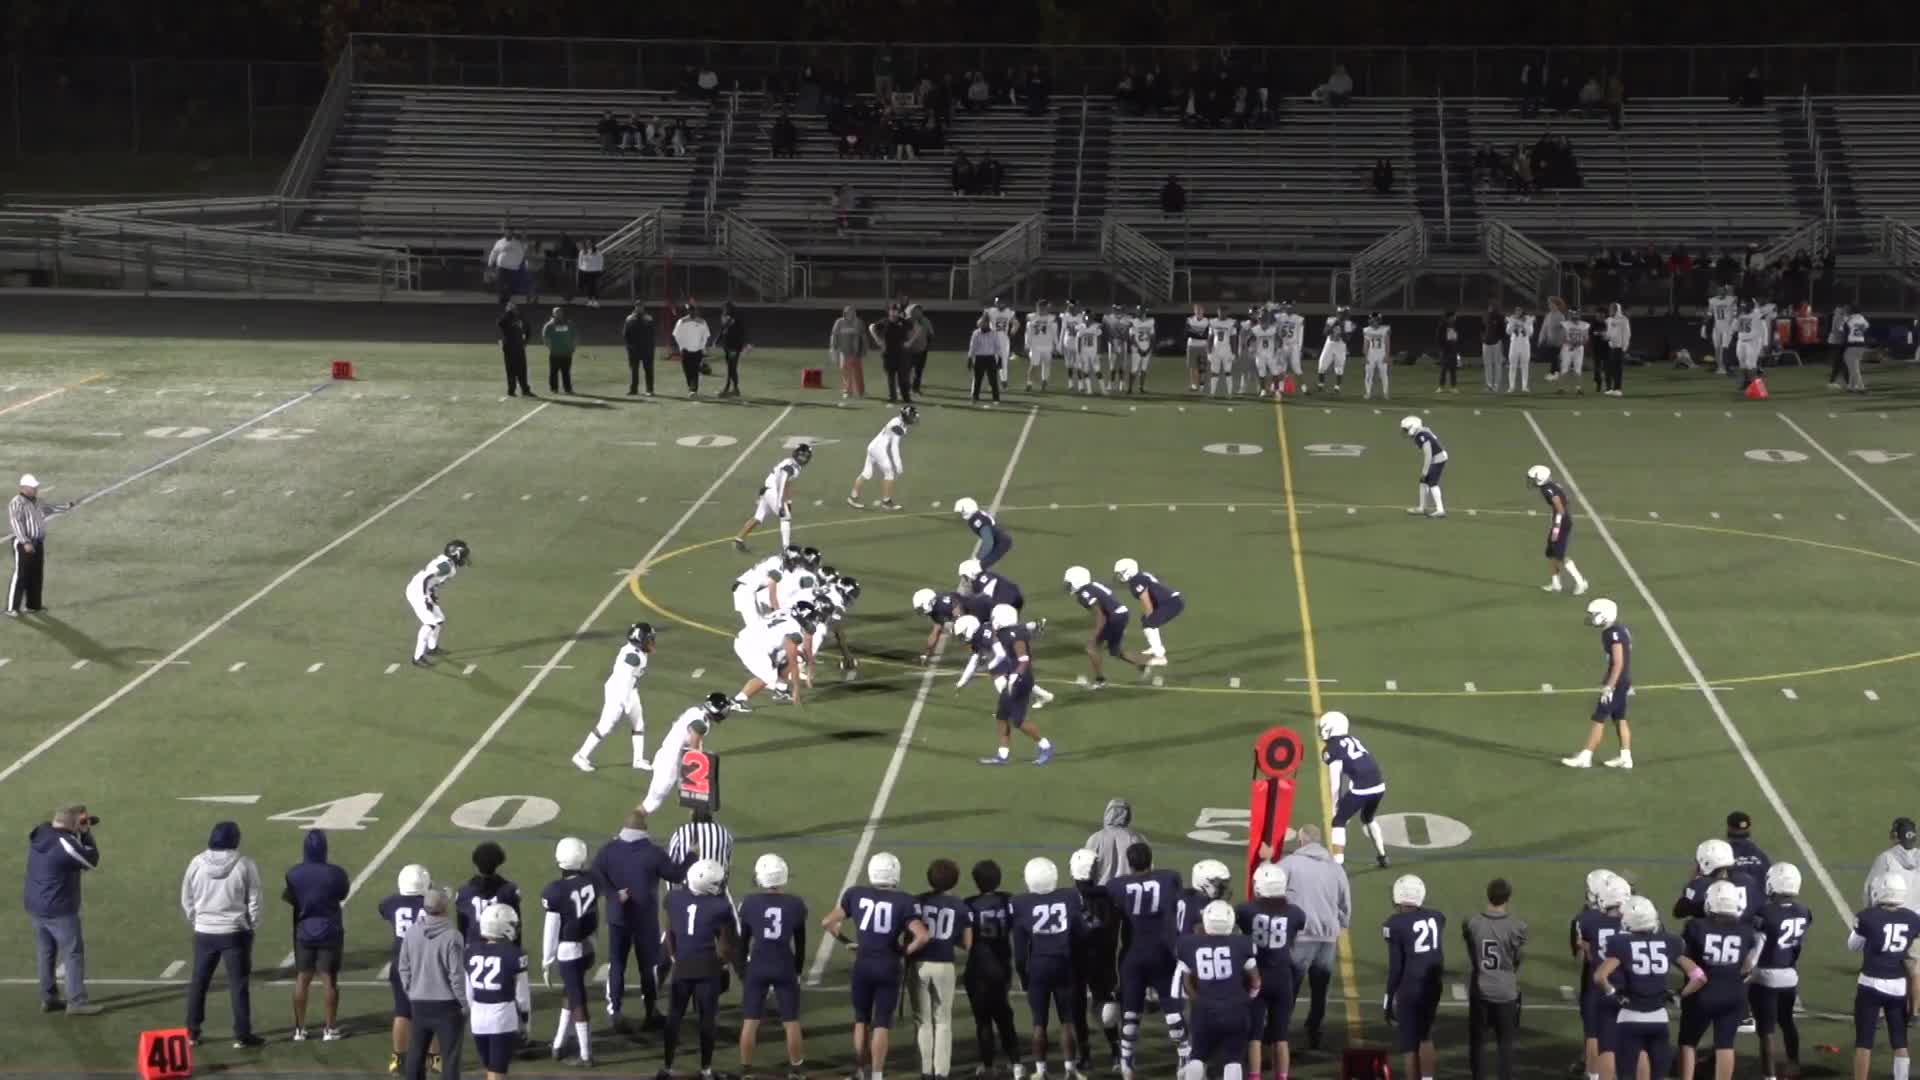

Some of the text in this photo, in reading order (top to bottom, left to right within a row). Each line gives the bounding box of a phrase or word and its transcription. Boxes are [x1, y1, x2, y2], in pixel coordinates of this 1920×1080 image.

[680, 751, 710, 793] 2
[1126, 880, 1161, 915] 77
[687, 903, 697, 936] 1
[764, 907, 783, 940] 3
[858, 898, 893, 934] 70
[1031, 903, 1068, 934] 23
[1252, 913, 1288, 949] 88
[1413, 917, 1438, 953] 21
[1703, 934, 1742, 964] 56
[1884, 923, 1916, 953] 15
[469, 955, 502, 990] 22
[1195, 946, 1232, 981] 66
[1481, 939, 1501, 971] 5
[1630, 941, 1668, 976] 55
[148, 1035, 189, 1073] 40
